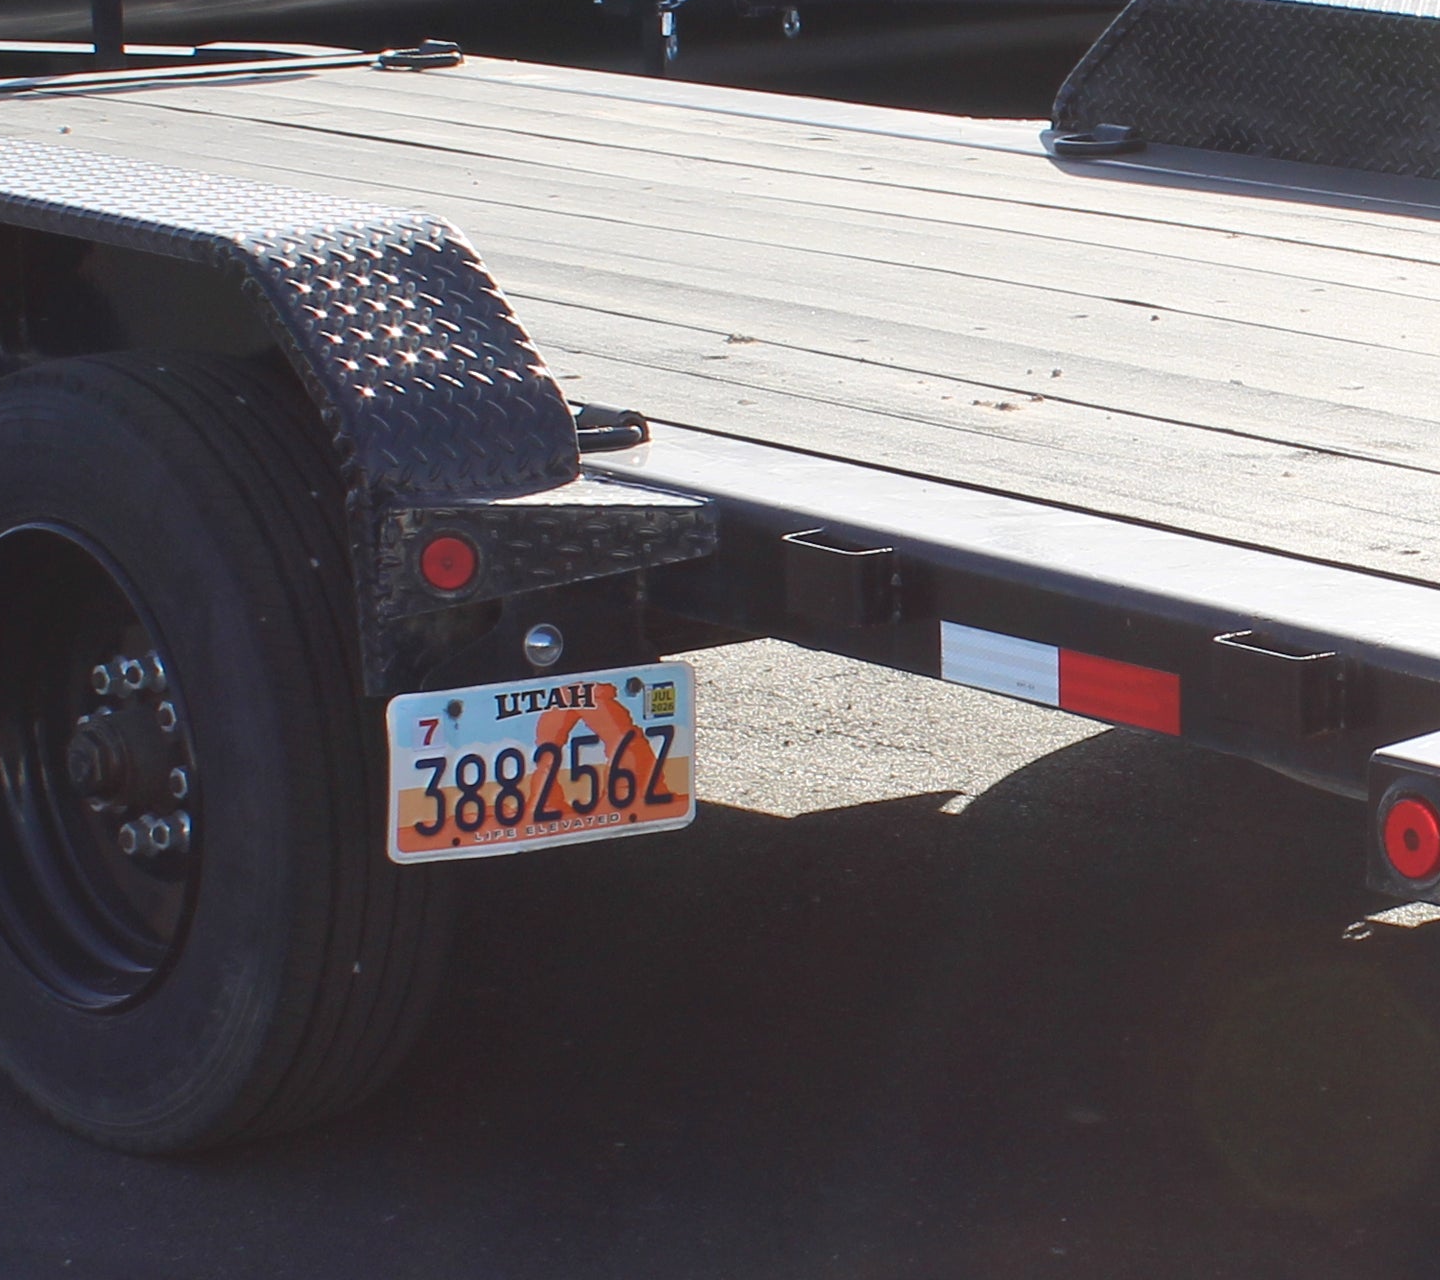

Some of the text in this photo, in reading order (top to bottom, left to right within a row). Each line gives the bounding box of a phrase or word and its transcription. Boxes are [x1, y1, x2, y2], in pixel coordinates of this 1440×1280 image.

[495, 682, 597, 721] UTAH
[652, 690, 673, 702] JUL
[418, 718, 440, 747] 7
[474, 812, 621, 842] LIFE ELEVATED
